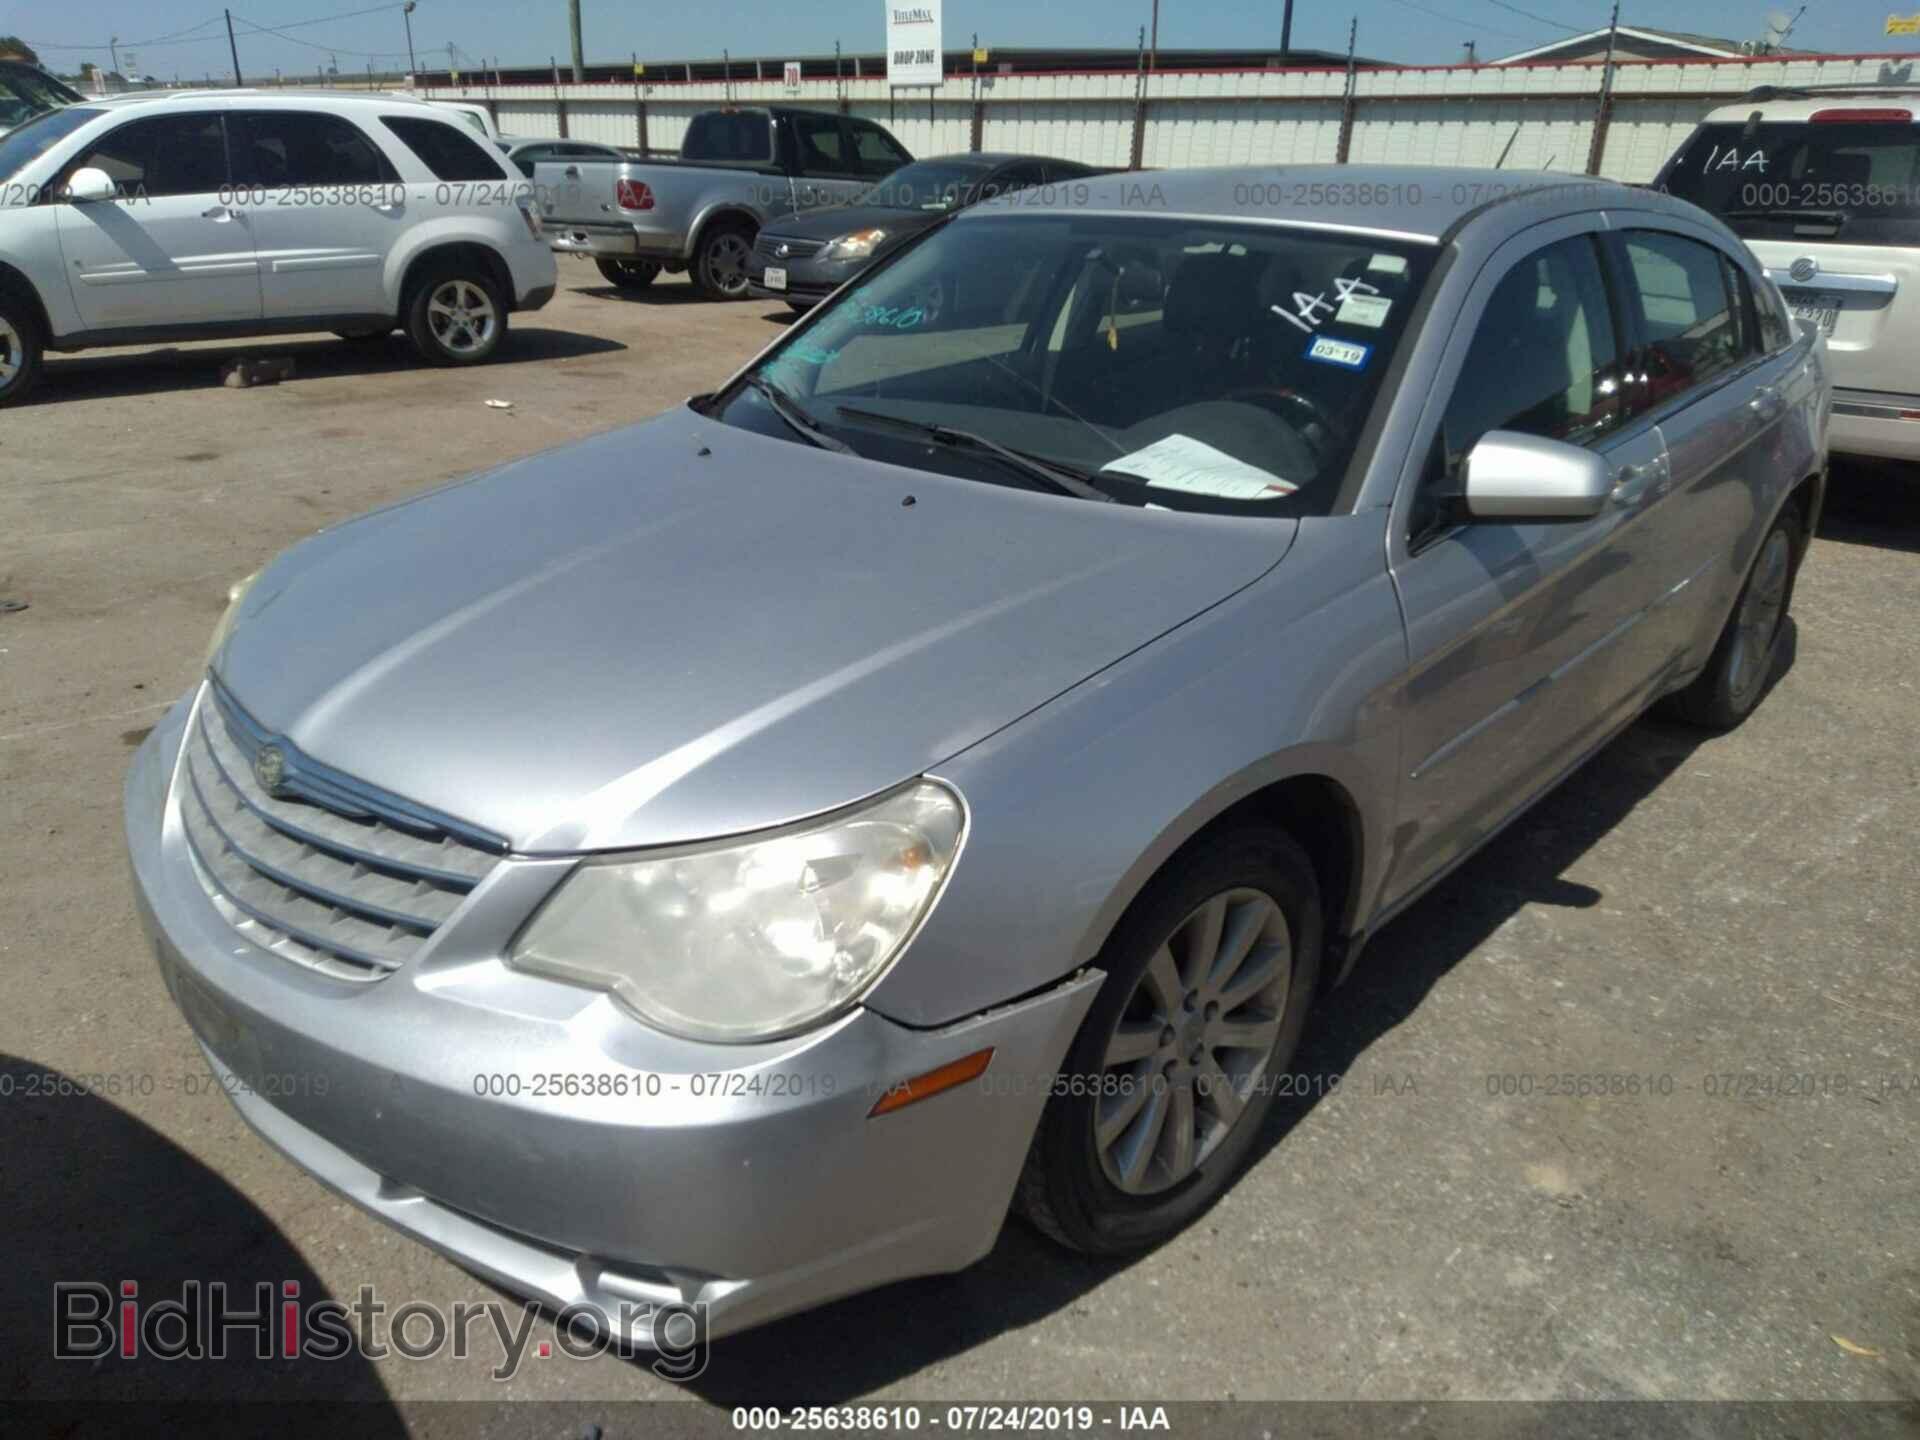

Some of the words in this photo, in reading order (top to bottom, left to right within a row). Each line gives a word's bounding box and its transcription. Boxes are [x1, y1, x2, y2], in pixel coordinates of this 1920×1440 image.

[893, 50, 914, 65] DROP
[915, 49, 934, 64] ZONE
[1703, 145, 1769, 174] IAA
[1270, 276, 1380, 333] IAA
